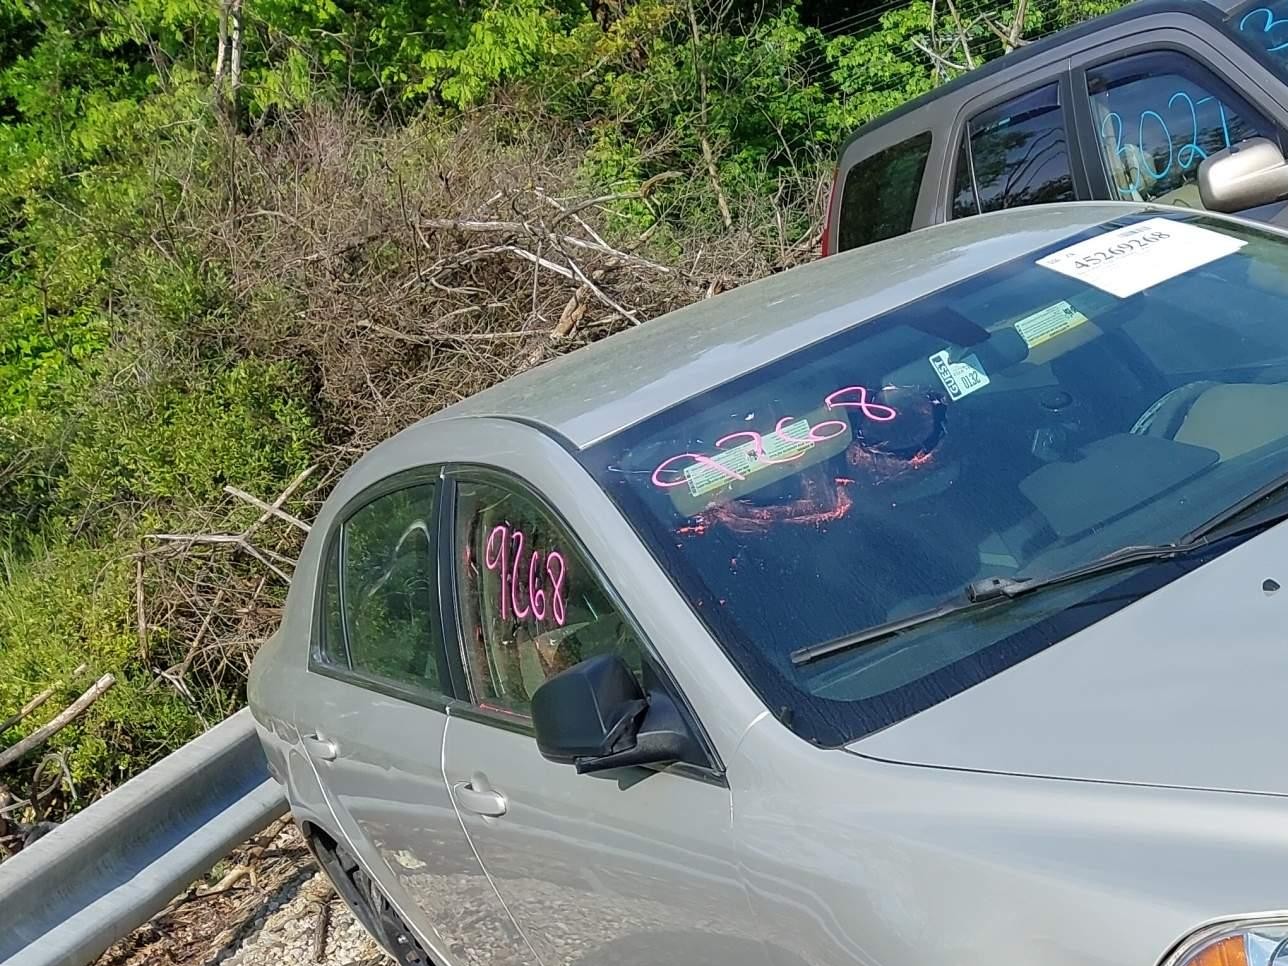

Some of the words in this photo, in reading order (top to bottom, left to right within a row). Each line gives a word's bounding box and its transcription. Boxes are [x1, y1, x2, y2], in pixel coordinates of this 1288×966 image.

[1101, 91, 1231, 194] 3027
[1074, 231, 1171, 270] 45269268
[933, 357, 959, 395] GUEST
[961, 370, 981, 389] 0132
[651, 386, 897, 487] 9268
[485, 525, 566, 626] 9268
